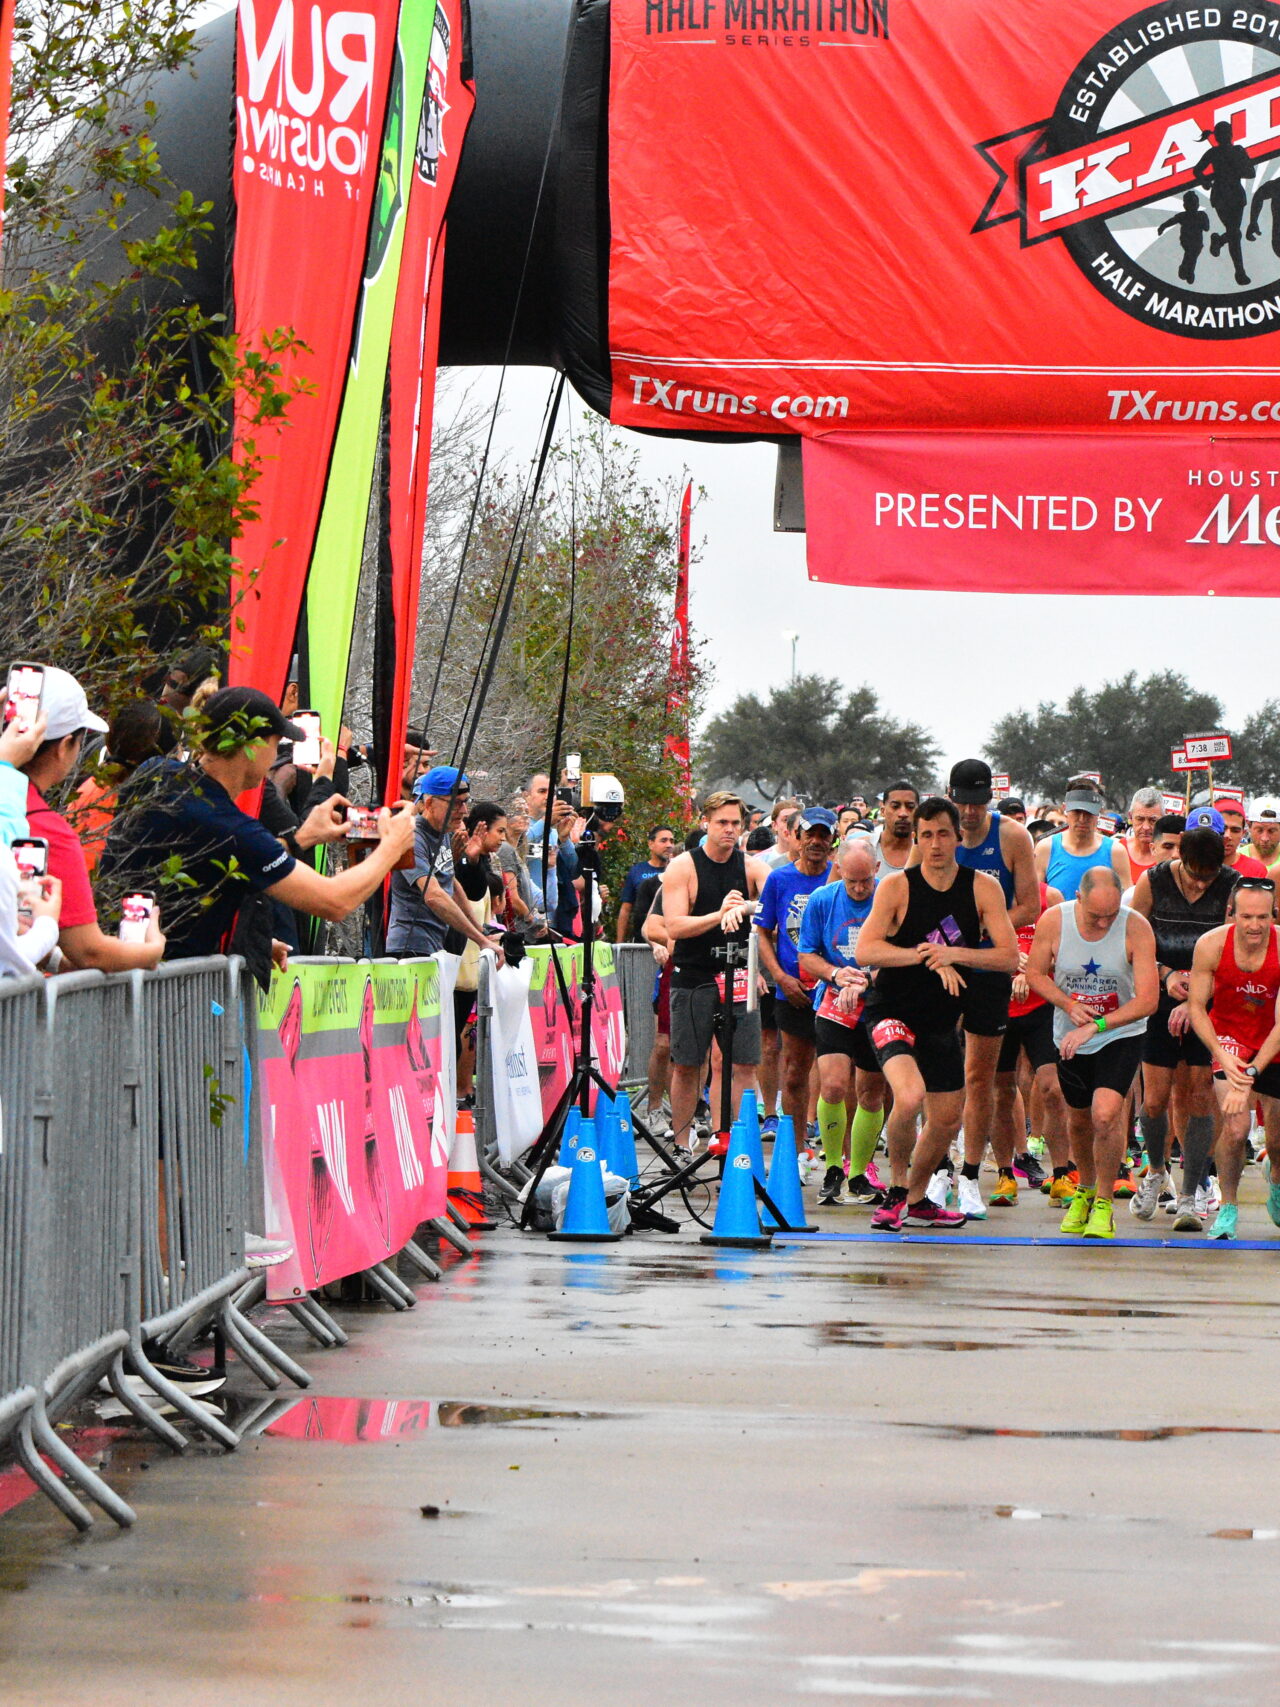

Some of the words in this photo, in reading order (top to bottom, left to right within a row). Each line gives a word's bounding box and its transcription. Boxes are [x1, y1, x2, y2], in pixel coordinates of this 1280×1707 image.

[645, 0, 716, 35] HALF
[724, 0, 890, 40] MARATHON
[725, 34, 811, 47] SERIES
[1068, 8, 1222, 123] ESTABLISHED
[1091, 250, 1146, 302] HALF
[629, 374, 849, 419] TXruns.com
[874, 491, 1099, 532] PRESENTED
[1113, 497, 1164, 533] BY
[1190, 744, 1209, 753] 7:38
[1092, 977, 1118, 986] AREA
